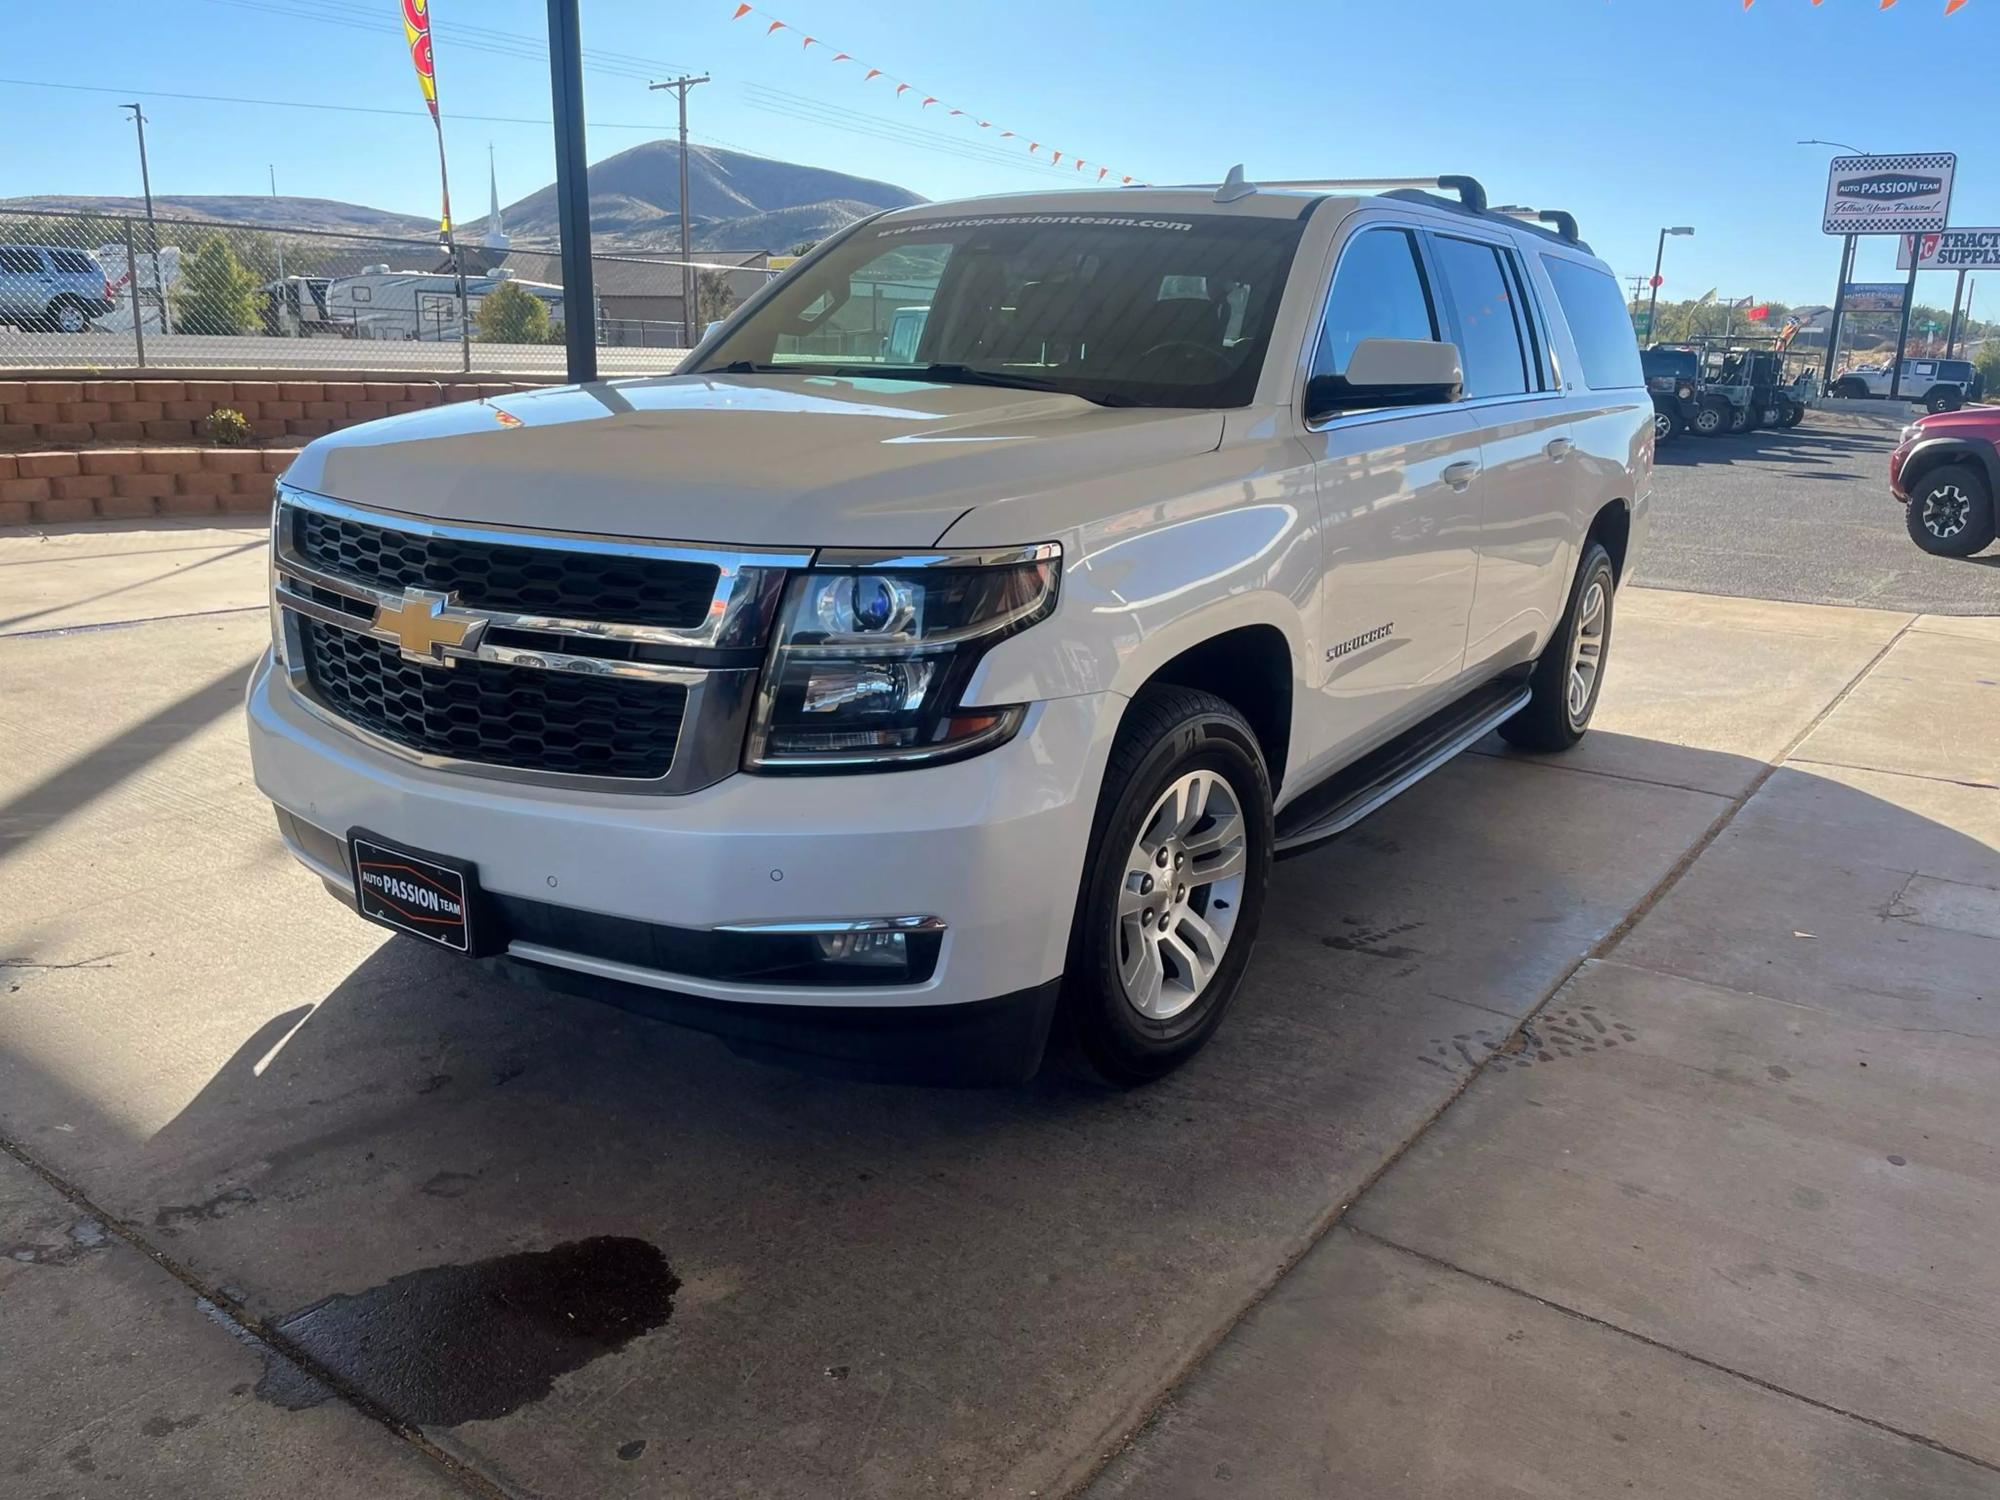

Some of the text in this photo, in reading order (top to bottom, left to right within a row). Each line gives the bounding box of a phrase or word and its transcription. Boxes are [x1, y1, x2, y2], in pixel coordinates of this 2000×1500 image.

[1839, 181, 1940, 195] AUTO PASSION TEAM
[1833, 200, 1941, 215] Follow Your Passion!
[876, 214, 1193, 238] www.autopassionteam.com
[362, 871, 461, 915] AUTO PASSION TEAM
